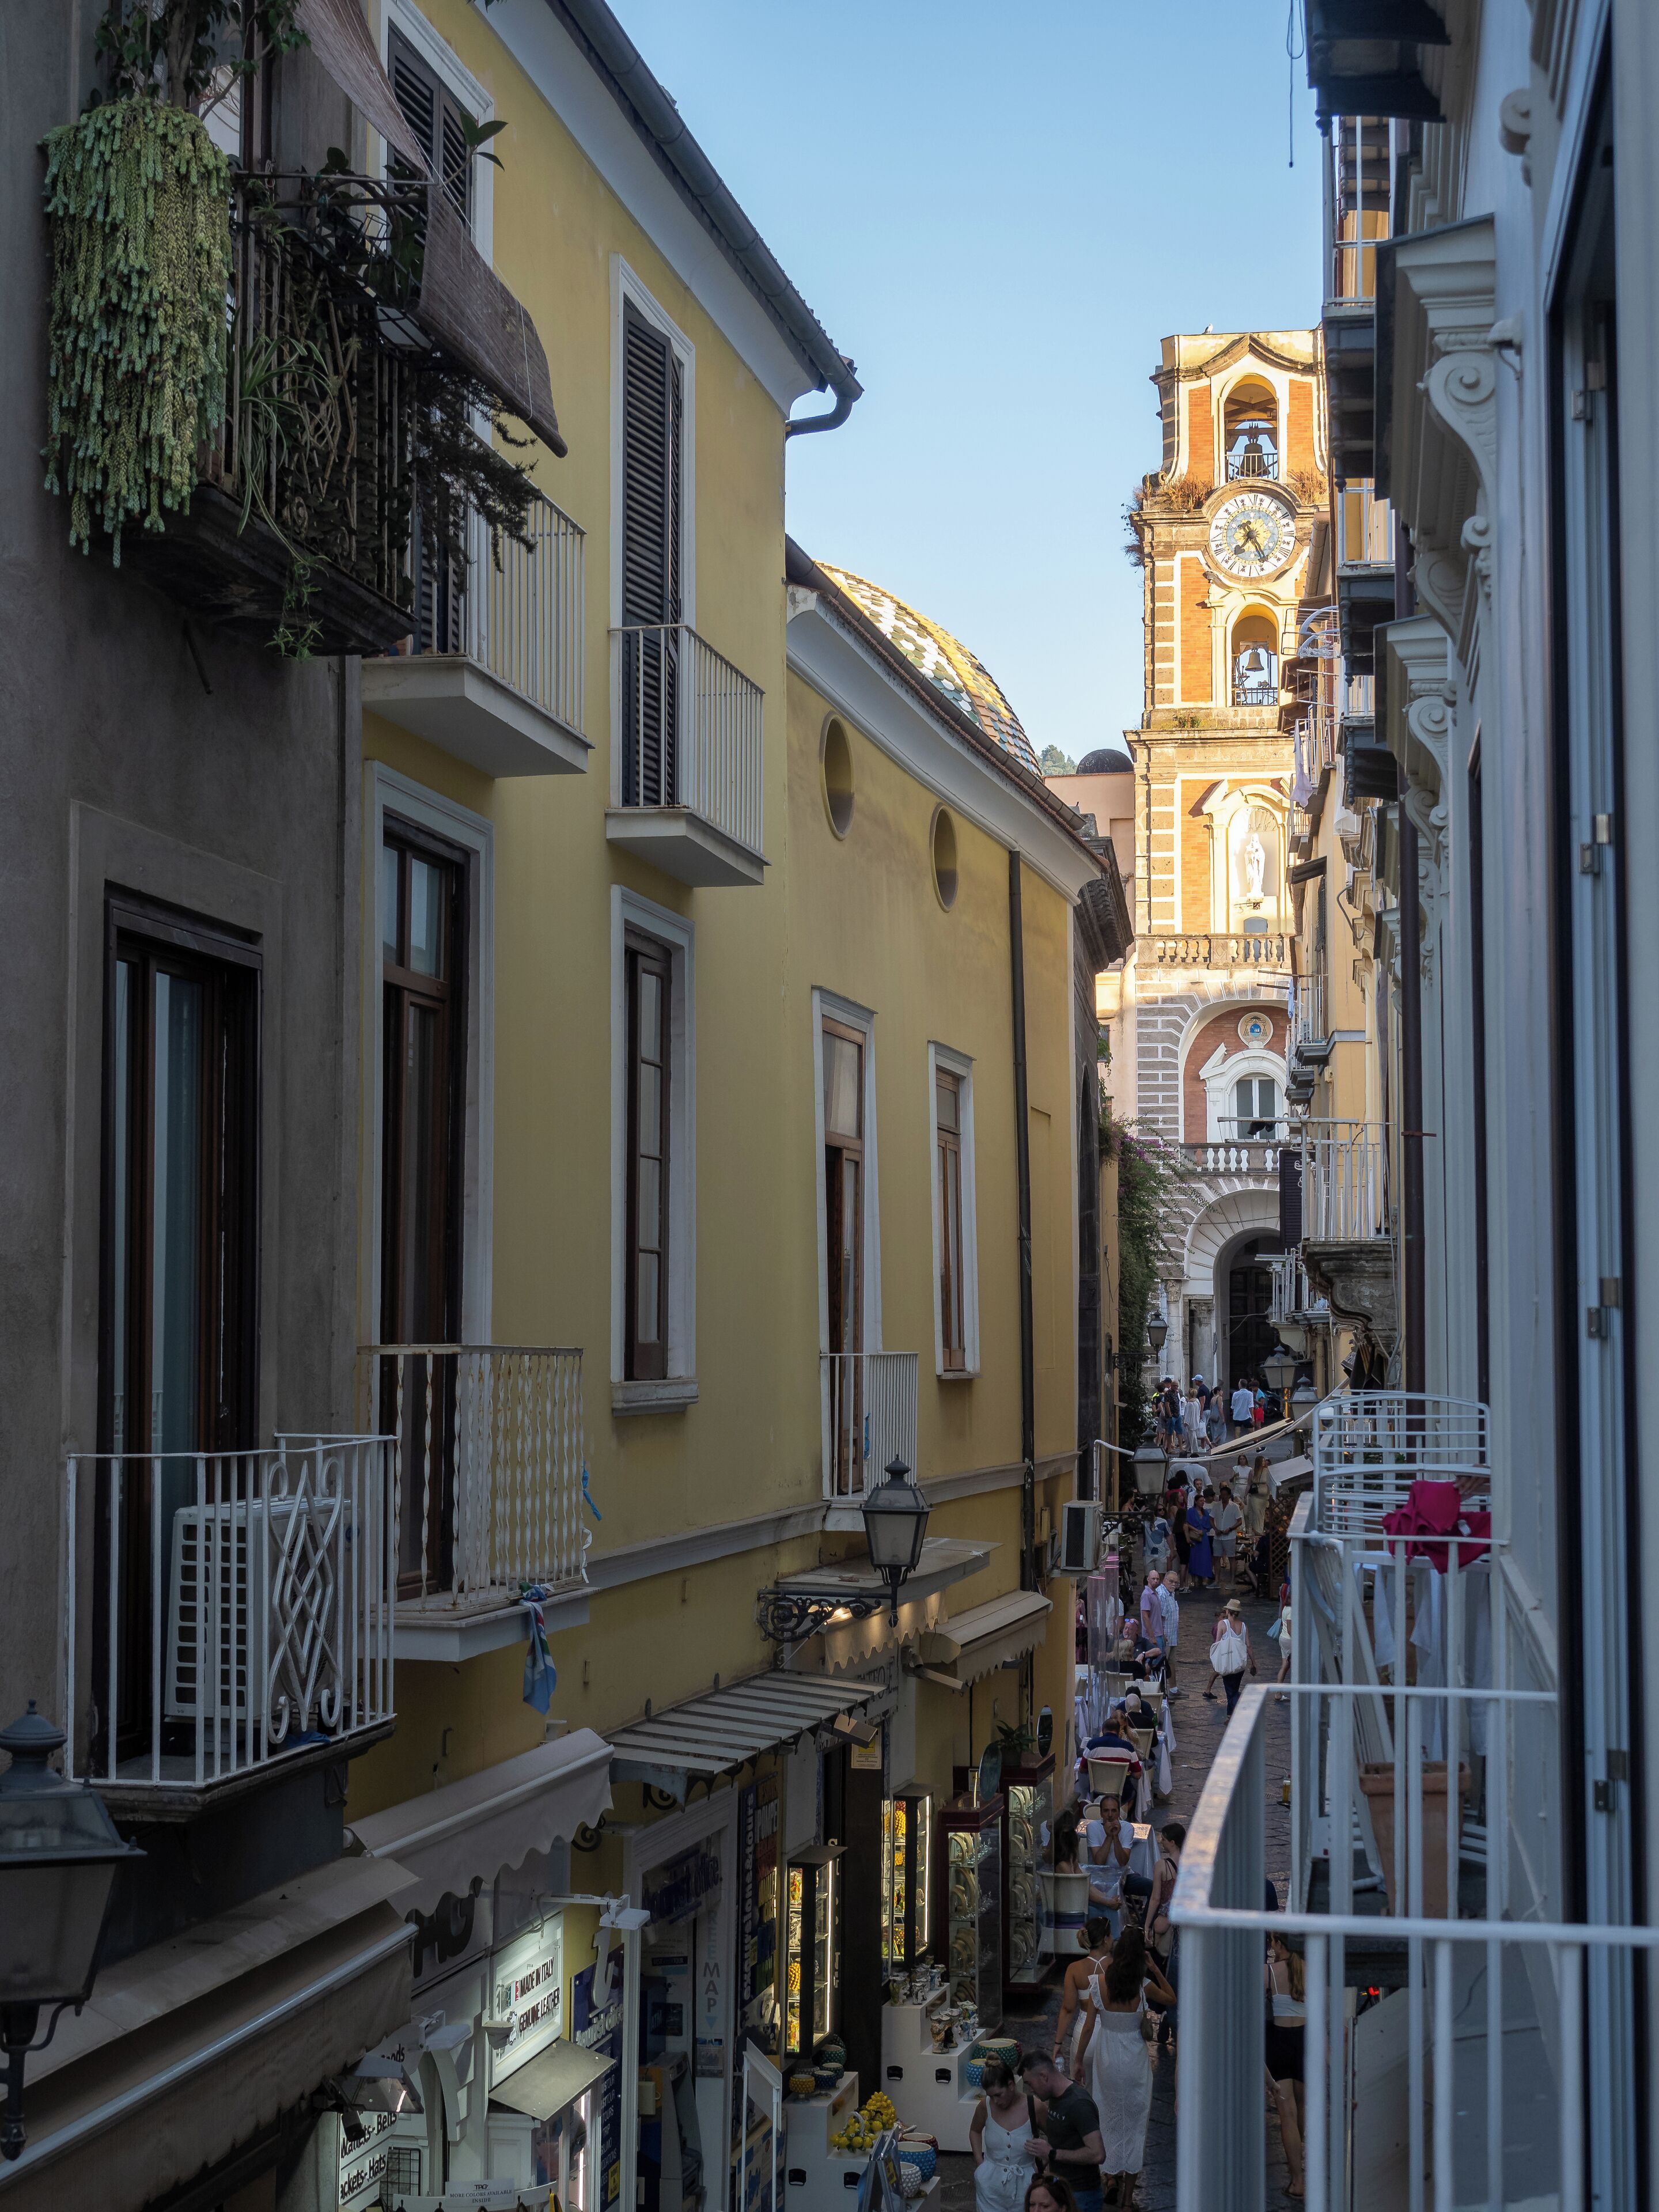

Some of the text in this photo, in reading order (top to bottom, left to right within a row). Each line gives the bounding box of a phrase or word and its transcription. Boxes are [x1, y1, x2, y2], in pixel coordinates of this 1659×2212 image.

[520, 1957, 554, 1998] MADE IN ITALY
[703, 1961, 721, 2013] MAP
[519, 1987, 560, 2033] GENUINE LEATHER
